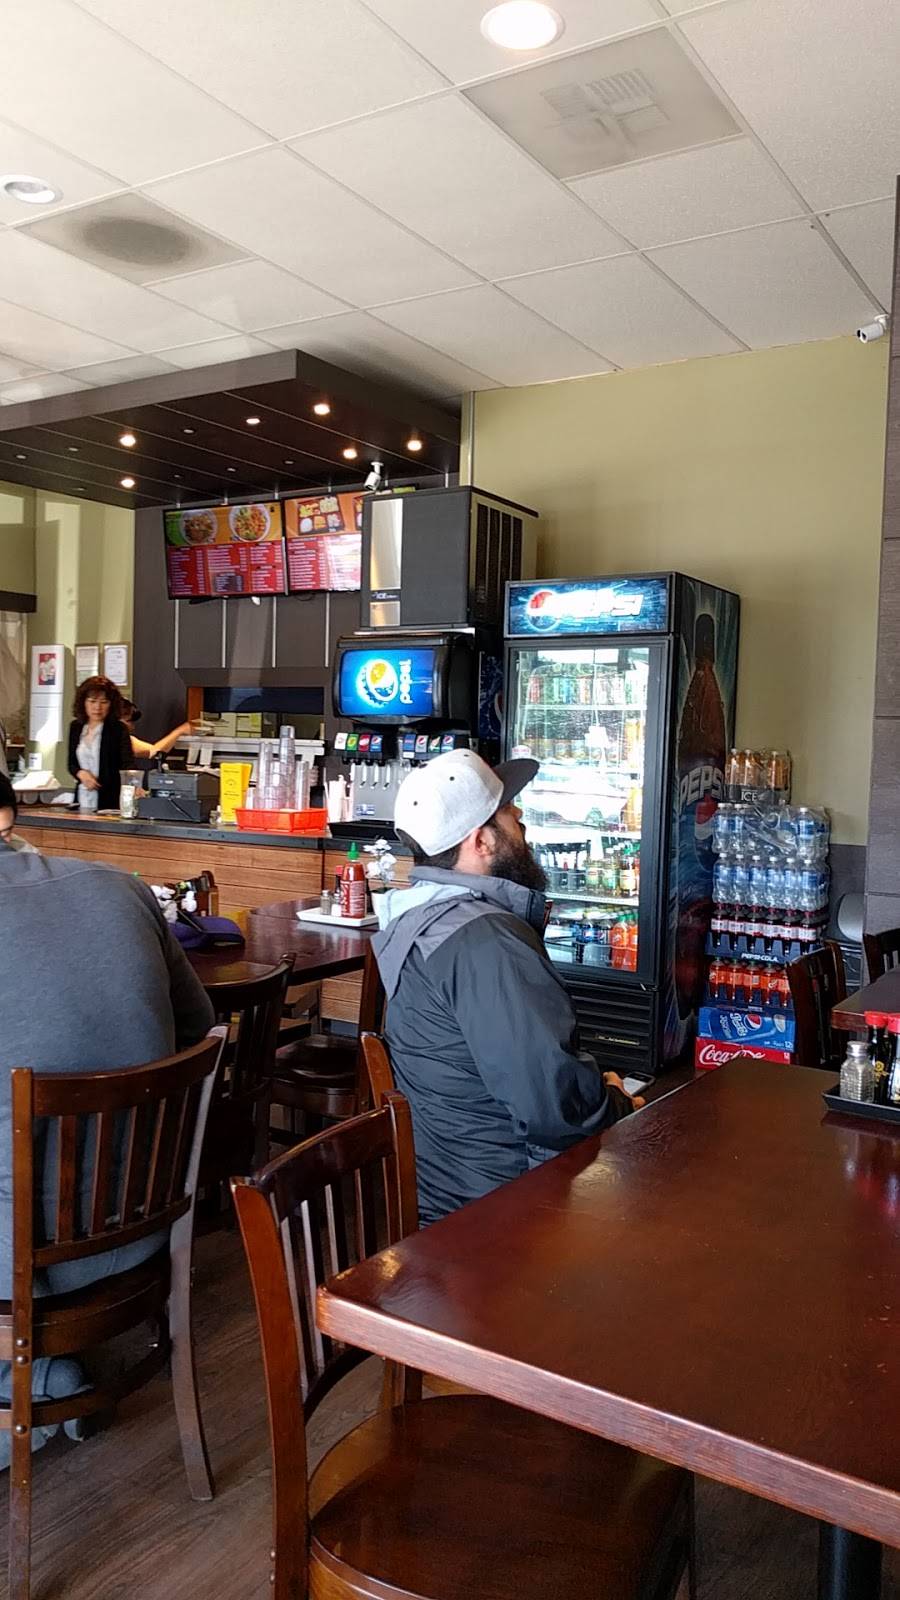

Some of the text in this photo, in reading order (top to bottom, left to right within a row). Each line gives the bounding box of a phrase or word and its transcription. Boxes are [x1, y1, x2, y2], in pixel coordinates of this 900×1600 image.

[551, 588, 644, 619] PSI
[741, 790, 758, 802] ICE
[741, 952, 779, 963] PEPSI-COLA
[699, 1044, 766, 1066] Coca-C
